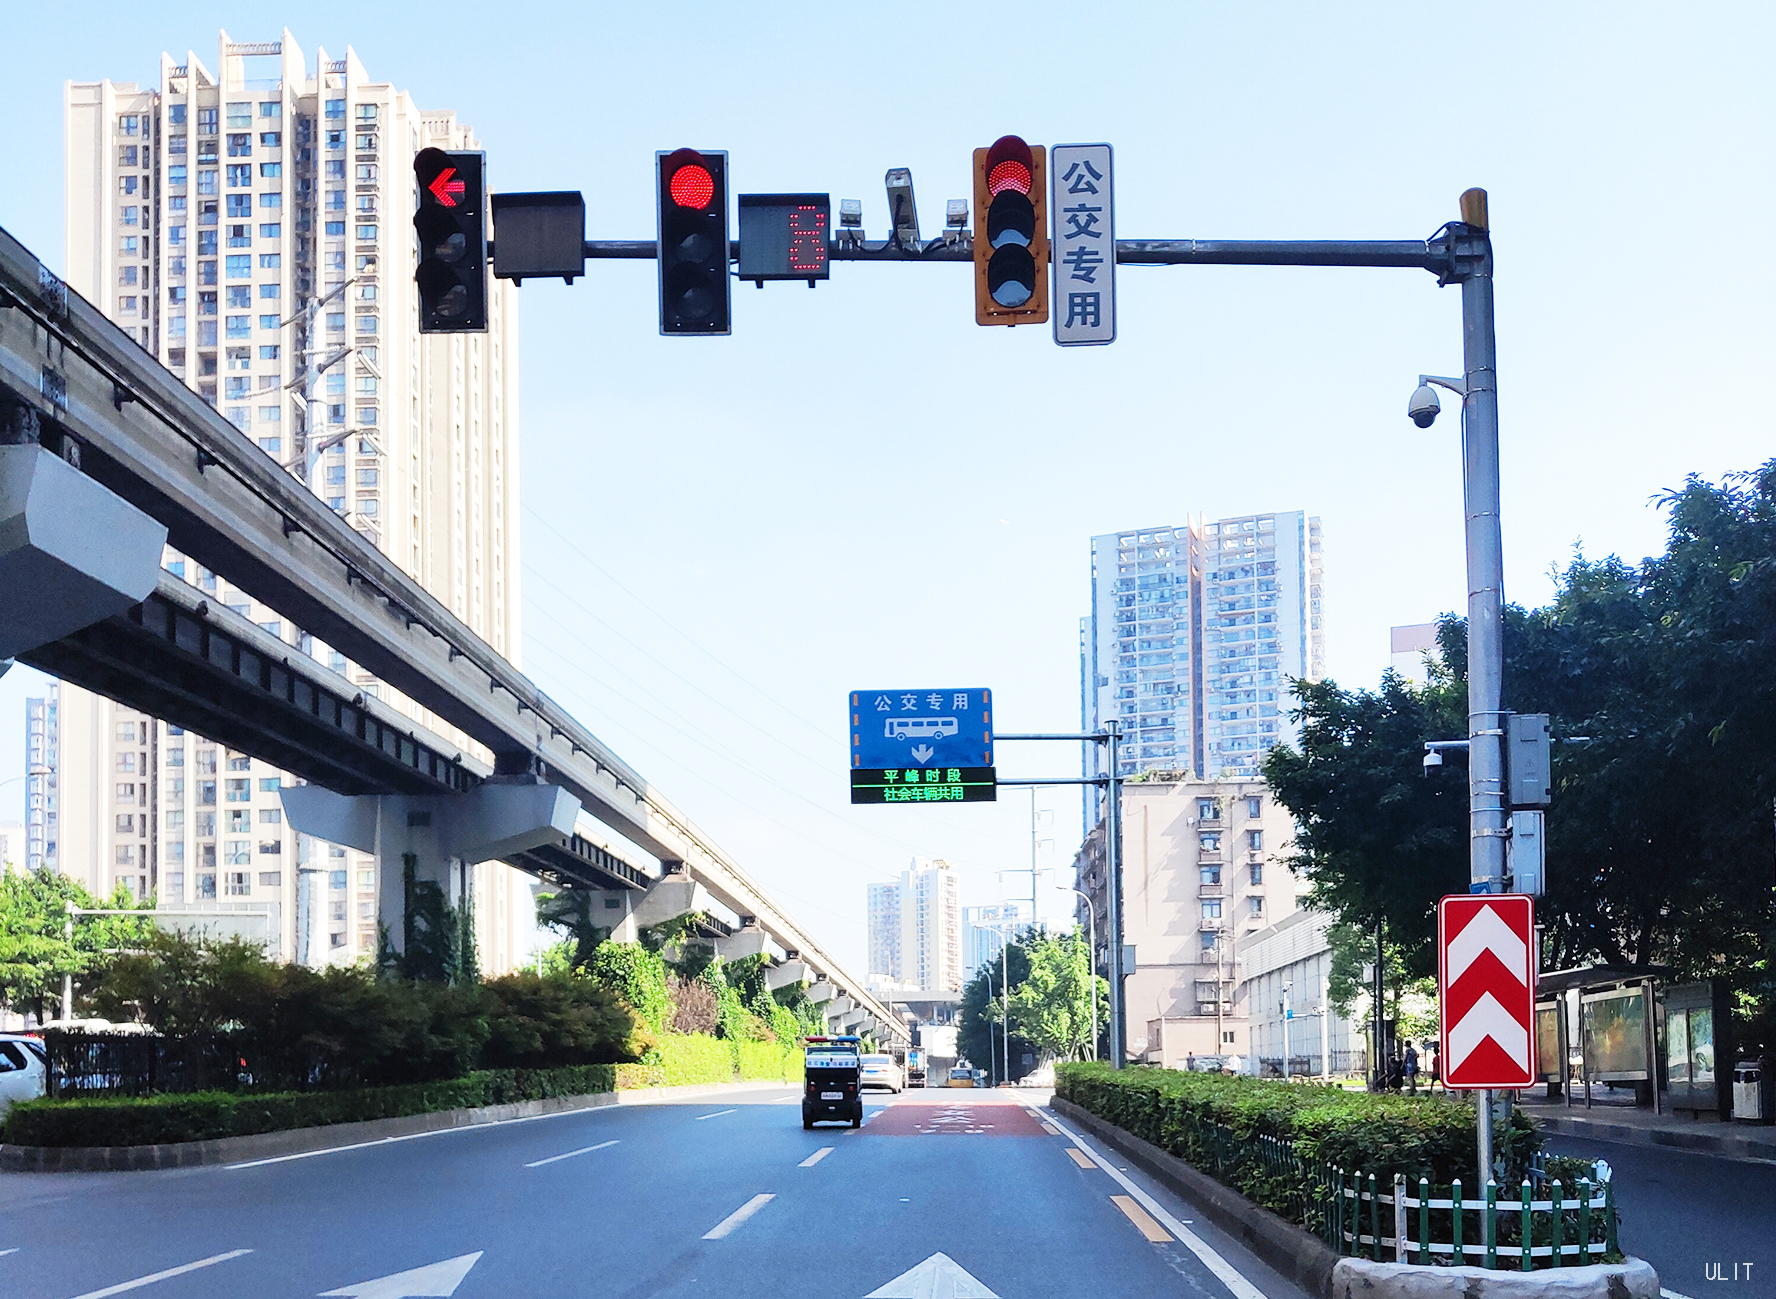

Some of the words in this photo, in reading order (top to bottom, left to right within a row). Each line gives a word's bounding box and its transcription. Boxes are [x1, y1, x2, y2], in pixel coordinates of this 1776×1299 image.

[1062, 160, 1103, 328] 公交专用
[874, 693, 968, 711] 公交专用
[883, 769, 962, 783] 平峰时段
[883, 787, 964, 801] 社会车辆共用
